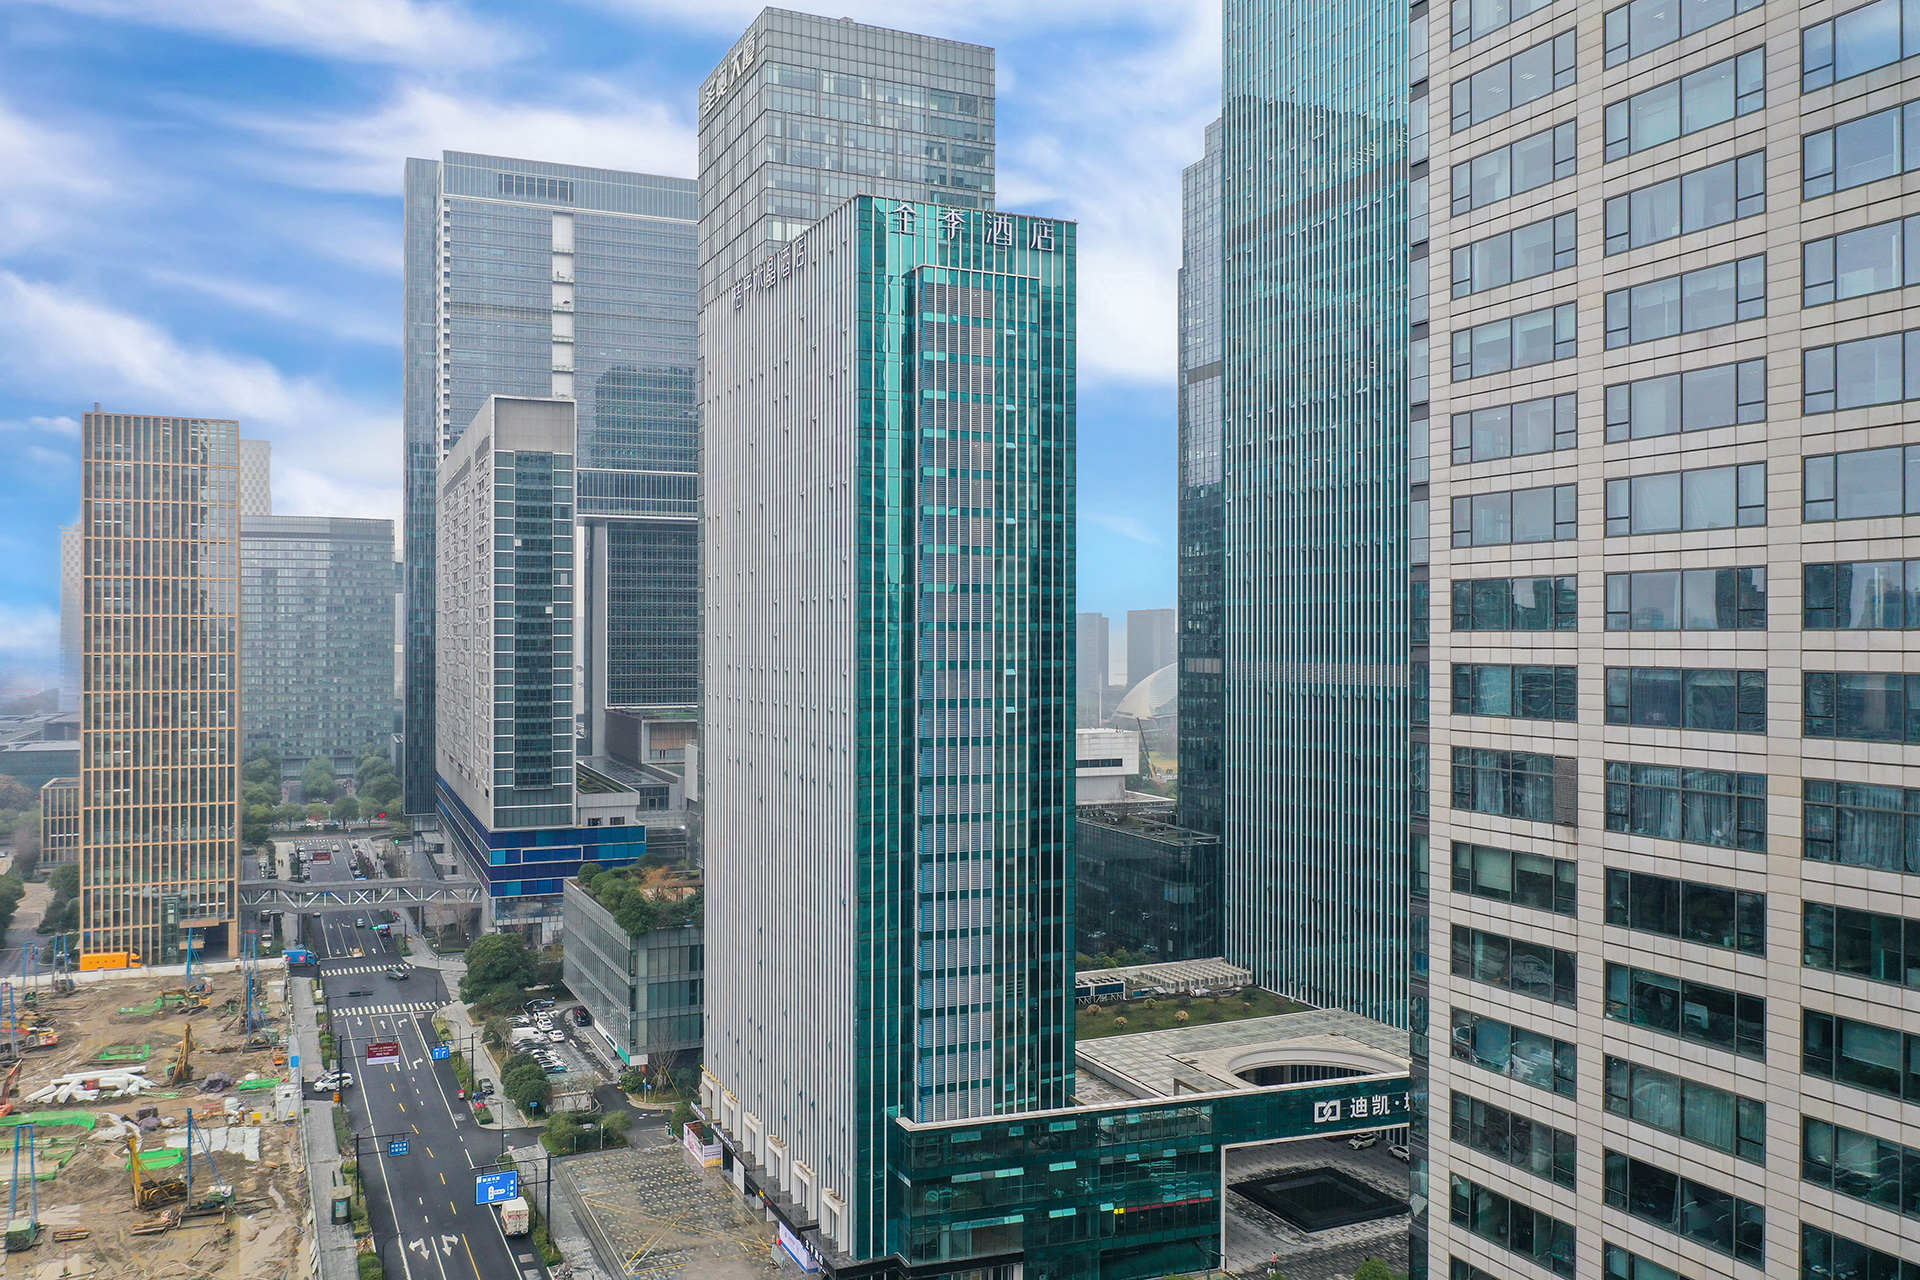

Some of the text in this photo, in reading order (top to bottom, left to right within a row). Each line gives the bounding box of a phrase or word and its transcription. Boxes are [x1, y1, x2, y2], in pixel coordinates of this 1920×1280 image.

[890, 203, 1055, 251] 全季酒店
[733, 235, 805, 311] 桔子水晶酒店
